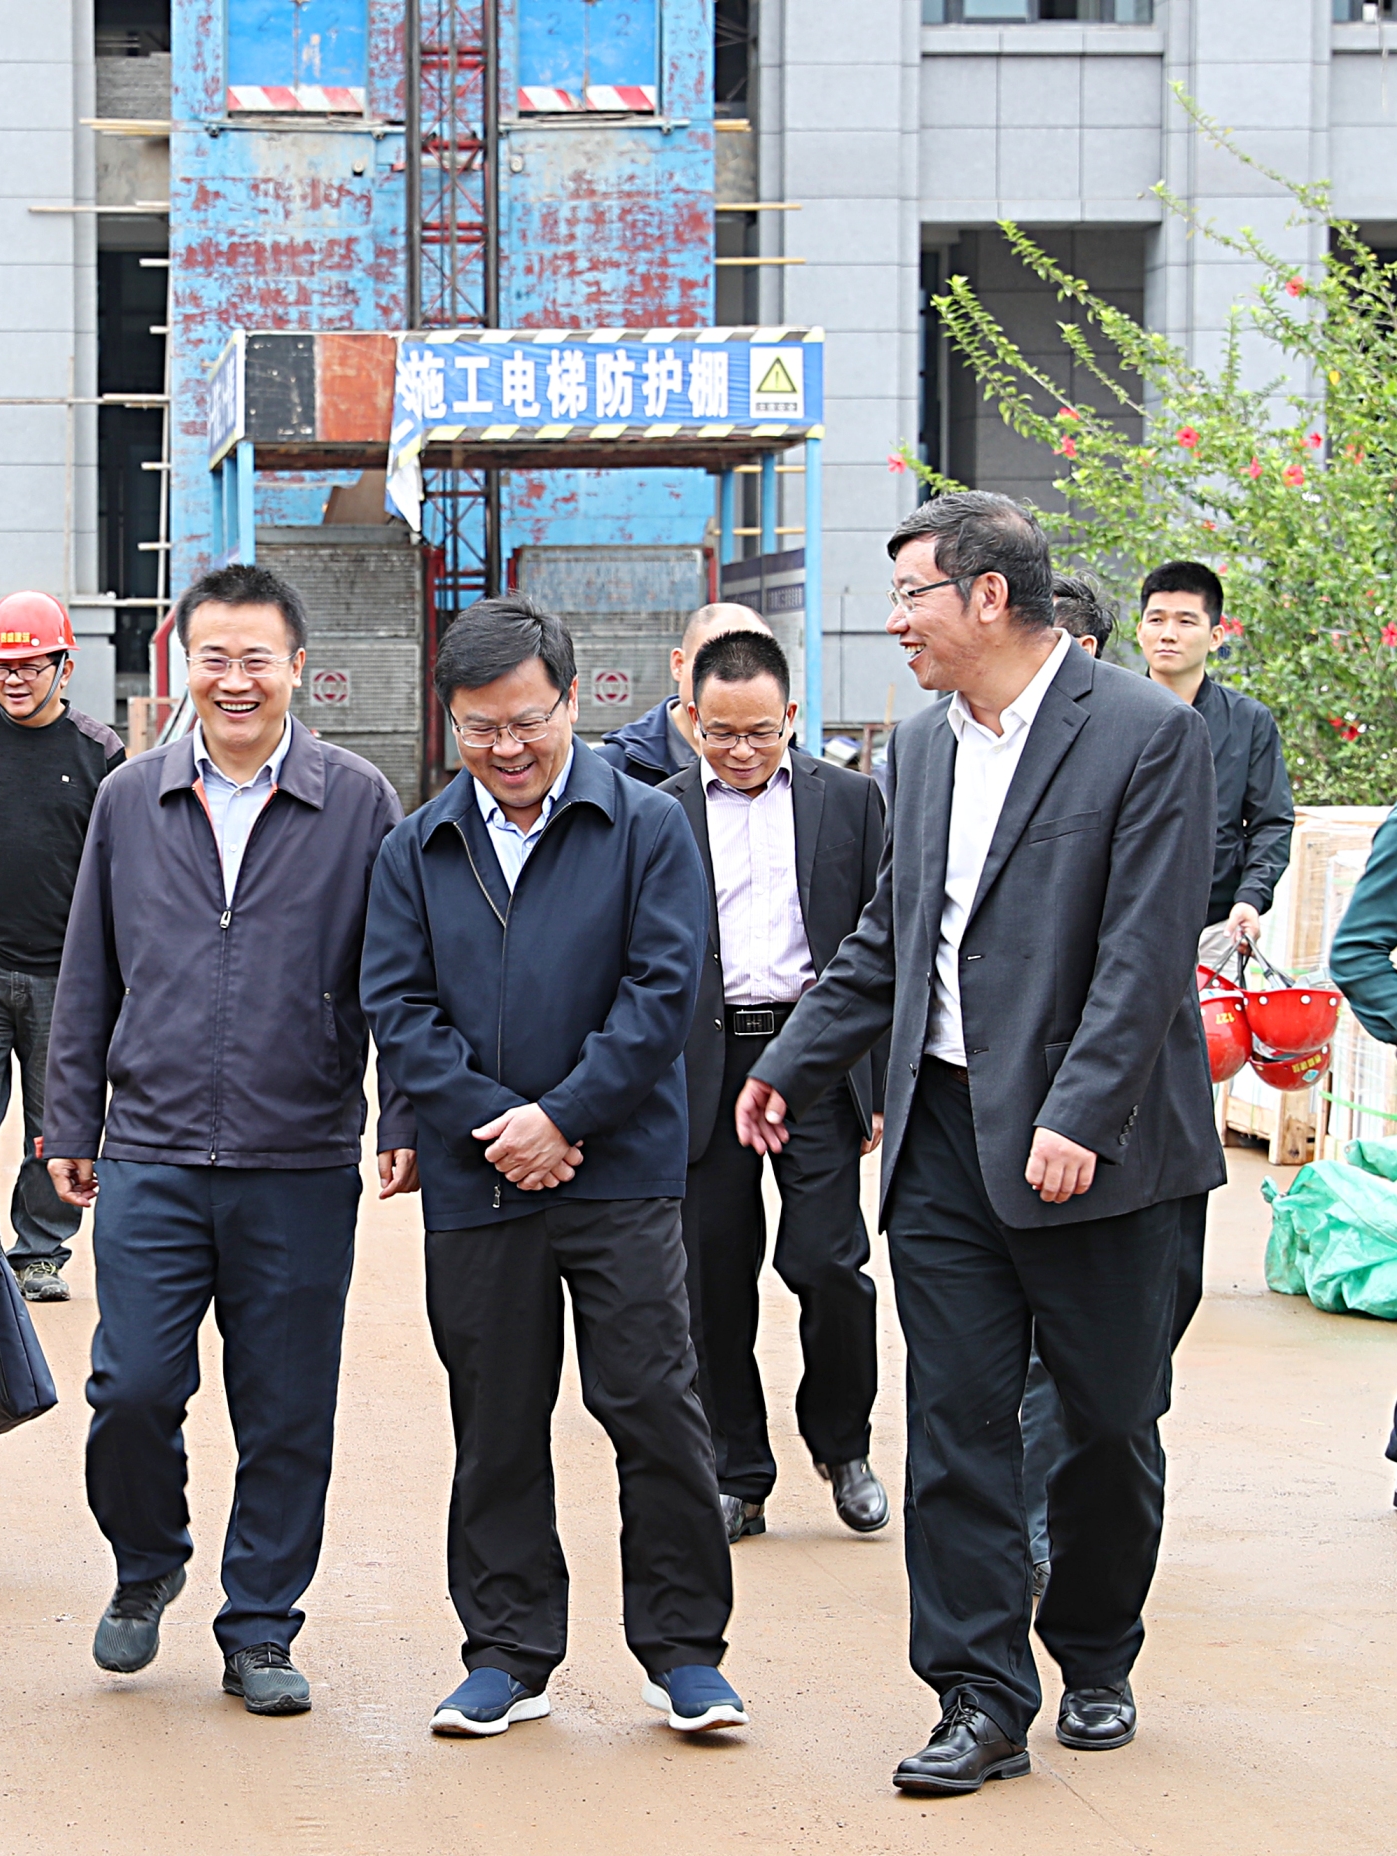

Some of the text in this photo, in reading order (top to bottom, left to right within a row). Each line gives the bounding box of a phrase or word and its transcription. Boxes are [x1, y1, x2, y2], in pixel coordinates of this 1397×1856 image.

[547, 12, 562, 35] 2
[615, 12, 631, 36] 2
[398, 348, 730, 419] 施工电梯防护棚
[1215, 1011, 1235, 1025] 127
